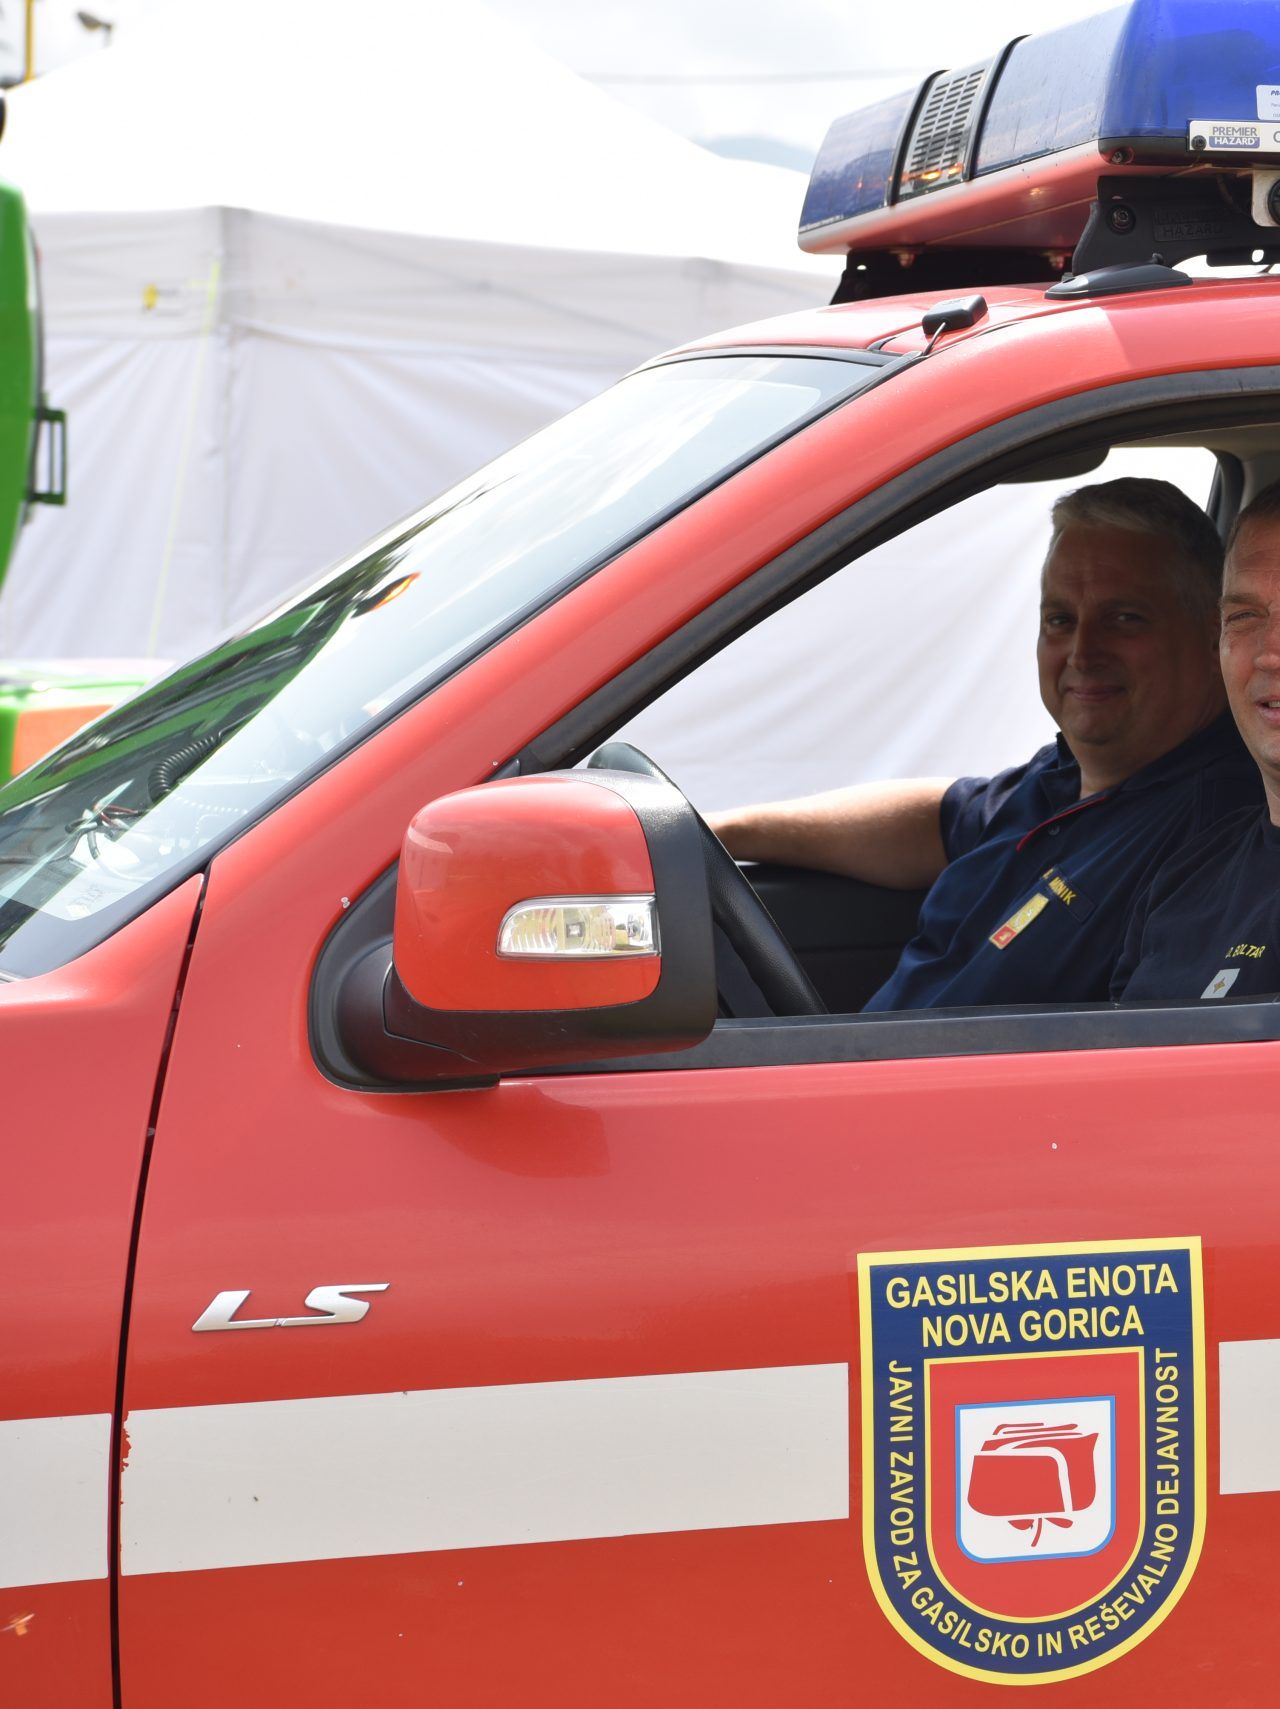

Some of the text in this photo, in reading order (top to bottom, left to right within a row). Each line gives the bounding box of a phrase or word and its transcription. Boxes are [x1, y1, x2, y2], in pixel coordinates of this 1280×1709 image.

[1212, 126, 1257, 137] PREMIER
[1214, 136, 1255, 145] HAZARD
[192, 1283, 390, 1331] LS
[885, 1263, 1179, 1309] GASILSKA ENOTA
[921, 1305, 1144, 1347] NOVA GORICA
[888, 1347, 1179, 1659] JAVNI ZAVOD ZA GASILSKO IN REŠEVALNO DEJAVNOST
